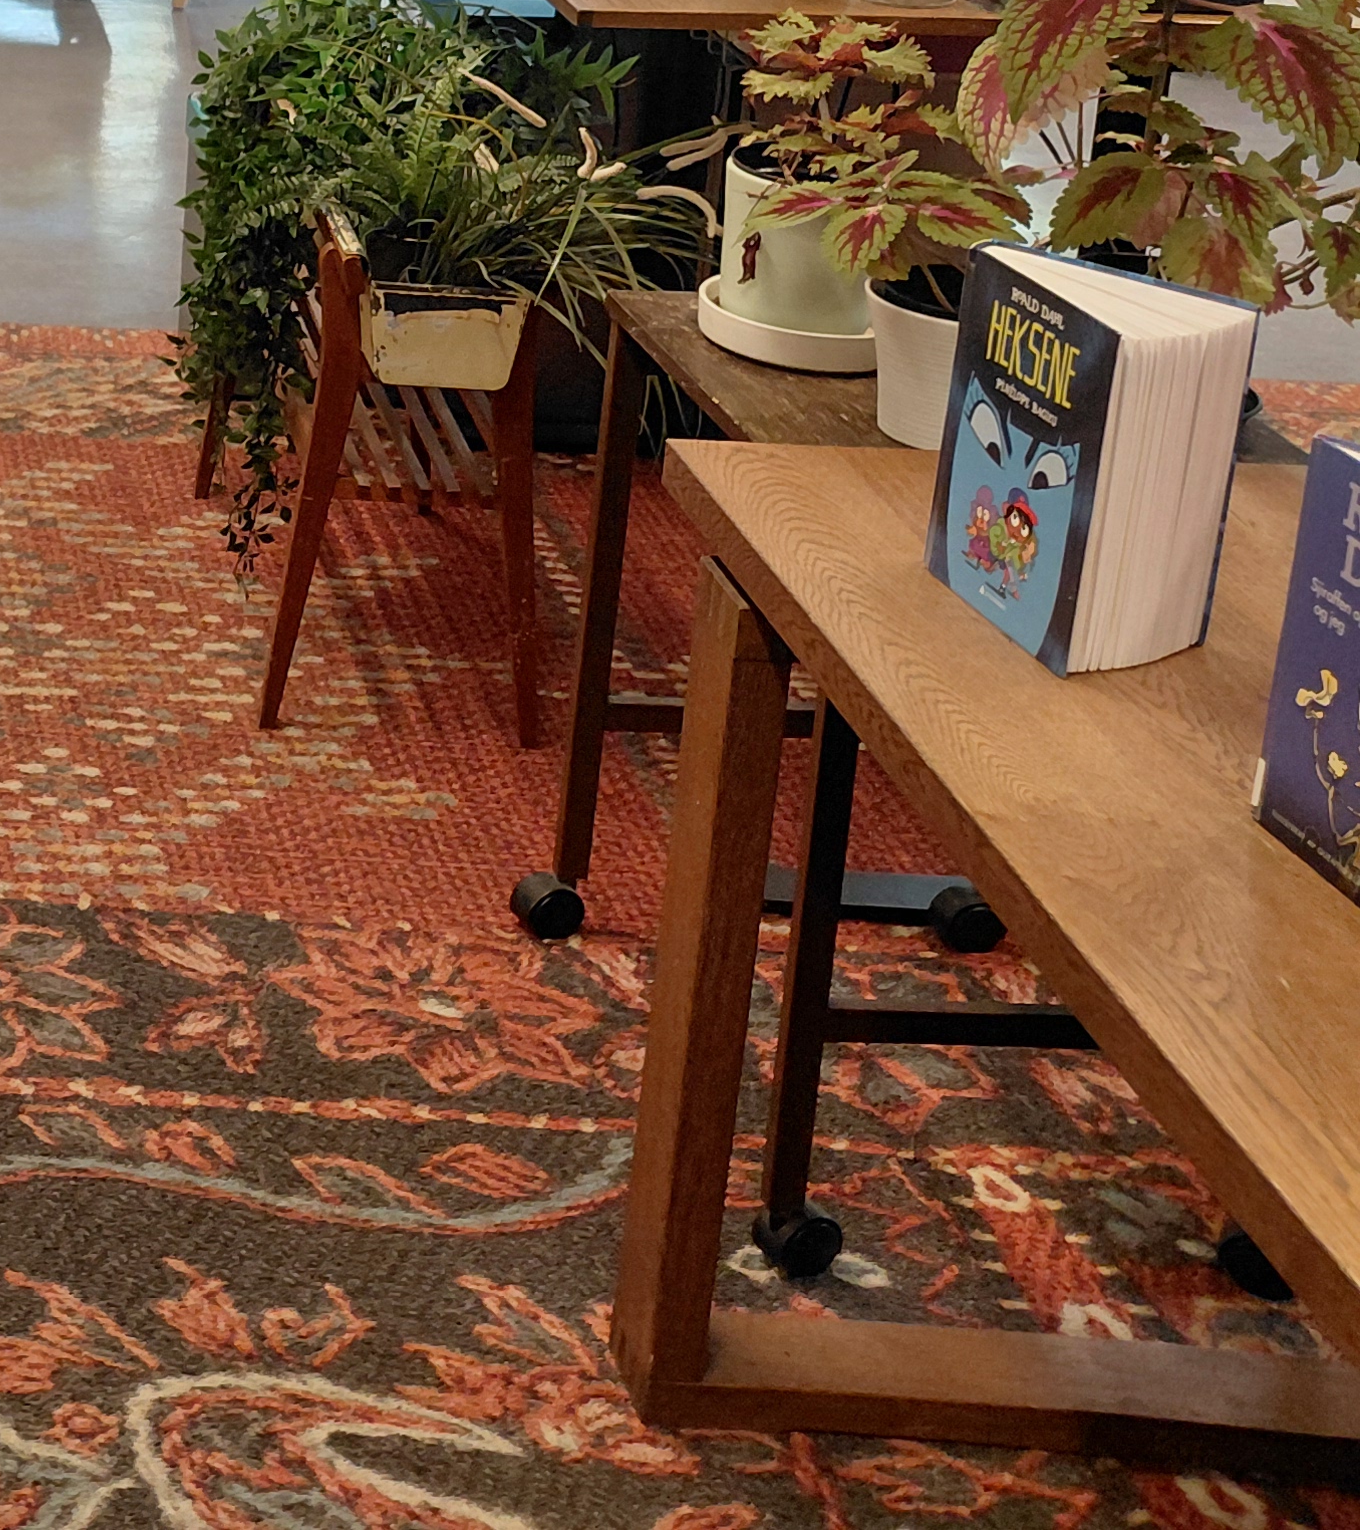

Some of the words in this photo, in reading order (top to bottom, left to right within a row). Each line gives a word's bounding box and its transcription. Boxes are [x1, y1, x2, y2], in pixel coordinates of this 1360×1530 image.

[1010, 286, 1040, 314] ROALD
[1040, 304, 1065, 331] DAHL
[985, 299, 1081, 410] HEKSENE
[1313, 604, 1328, 624] og
[1328, 610, 1346, 637] jeg
